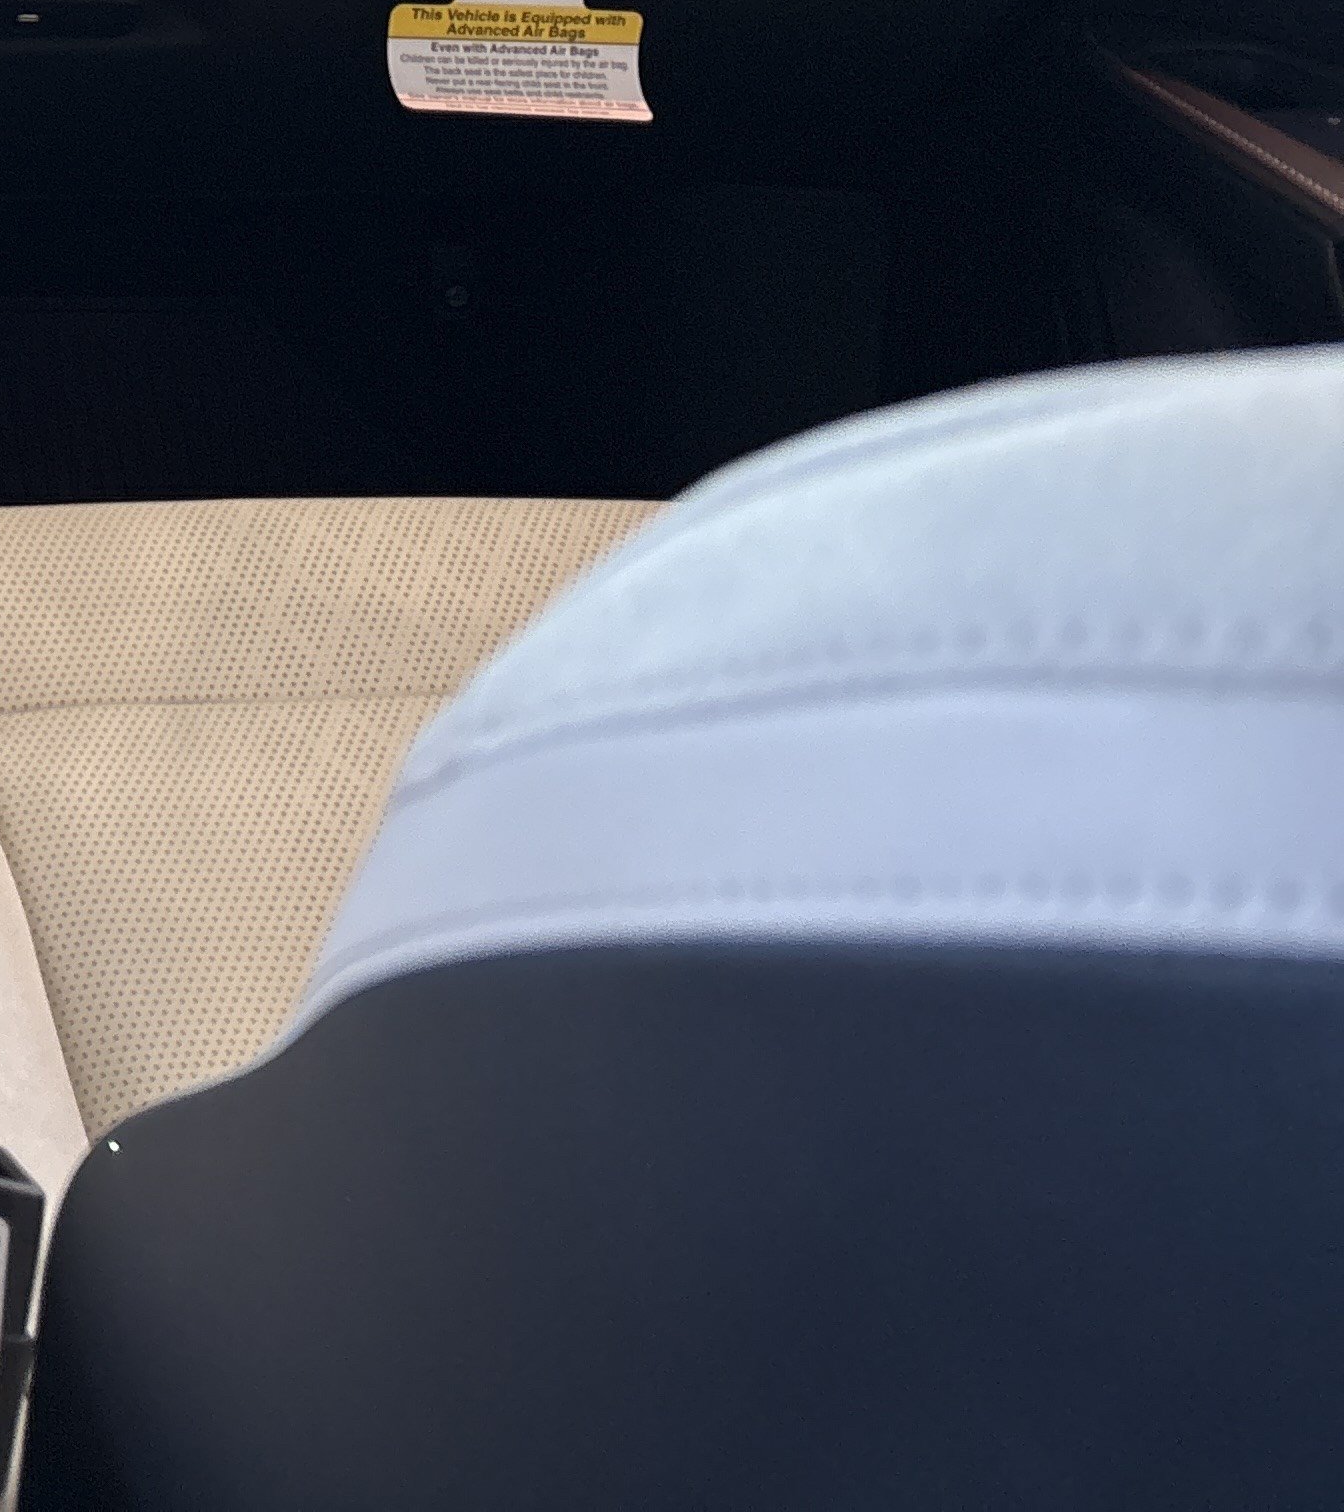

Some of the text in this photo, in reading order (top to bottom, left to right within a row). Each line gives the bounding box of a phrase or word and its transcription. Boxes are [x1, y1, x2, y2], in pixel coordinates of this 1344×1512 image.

[412, 7, 626, 27] This Vehicle is Equipped with
[446, 23, 586, 41] Advanced Air Bags
[430, 41, 599, 58] Even with Advanced Air Bags
